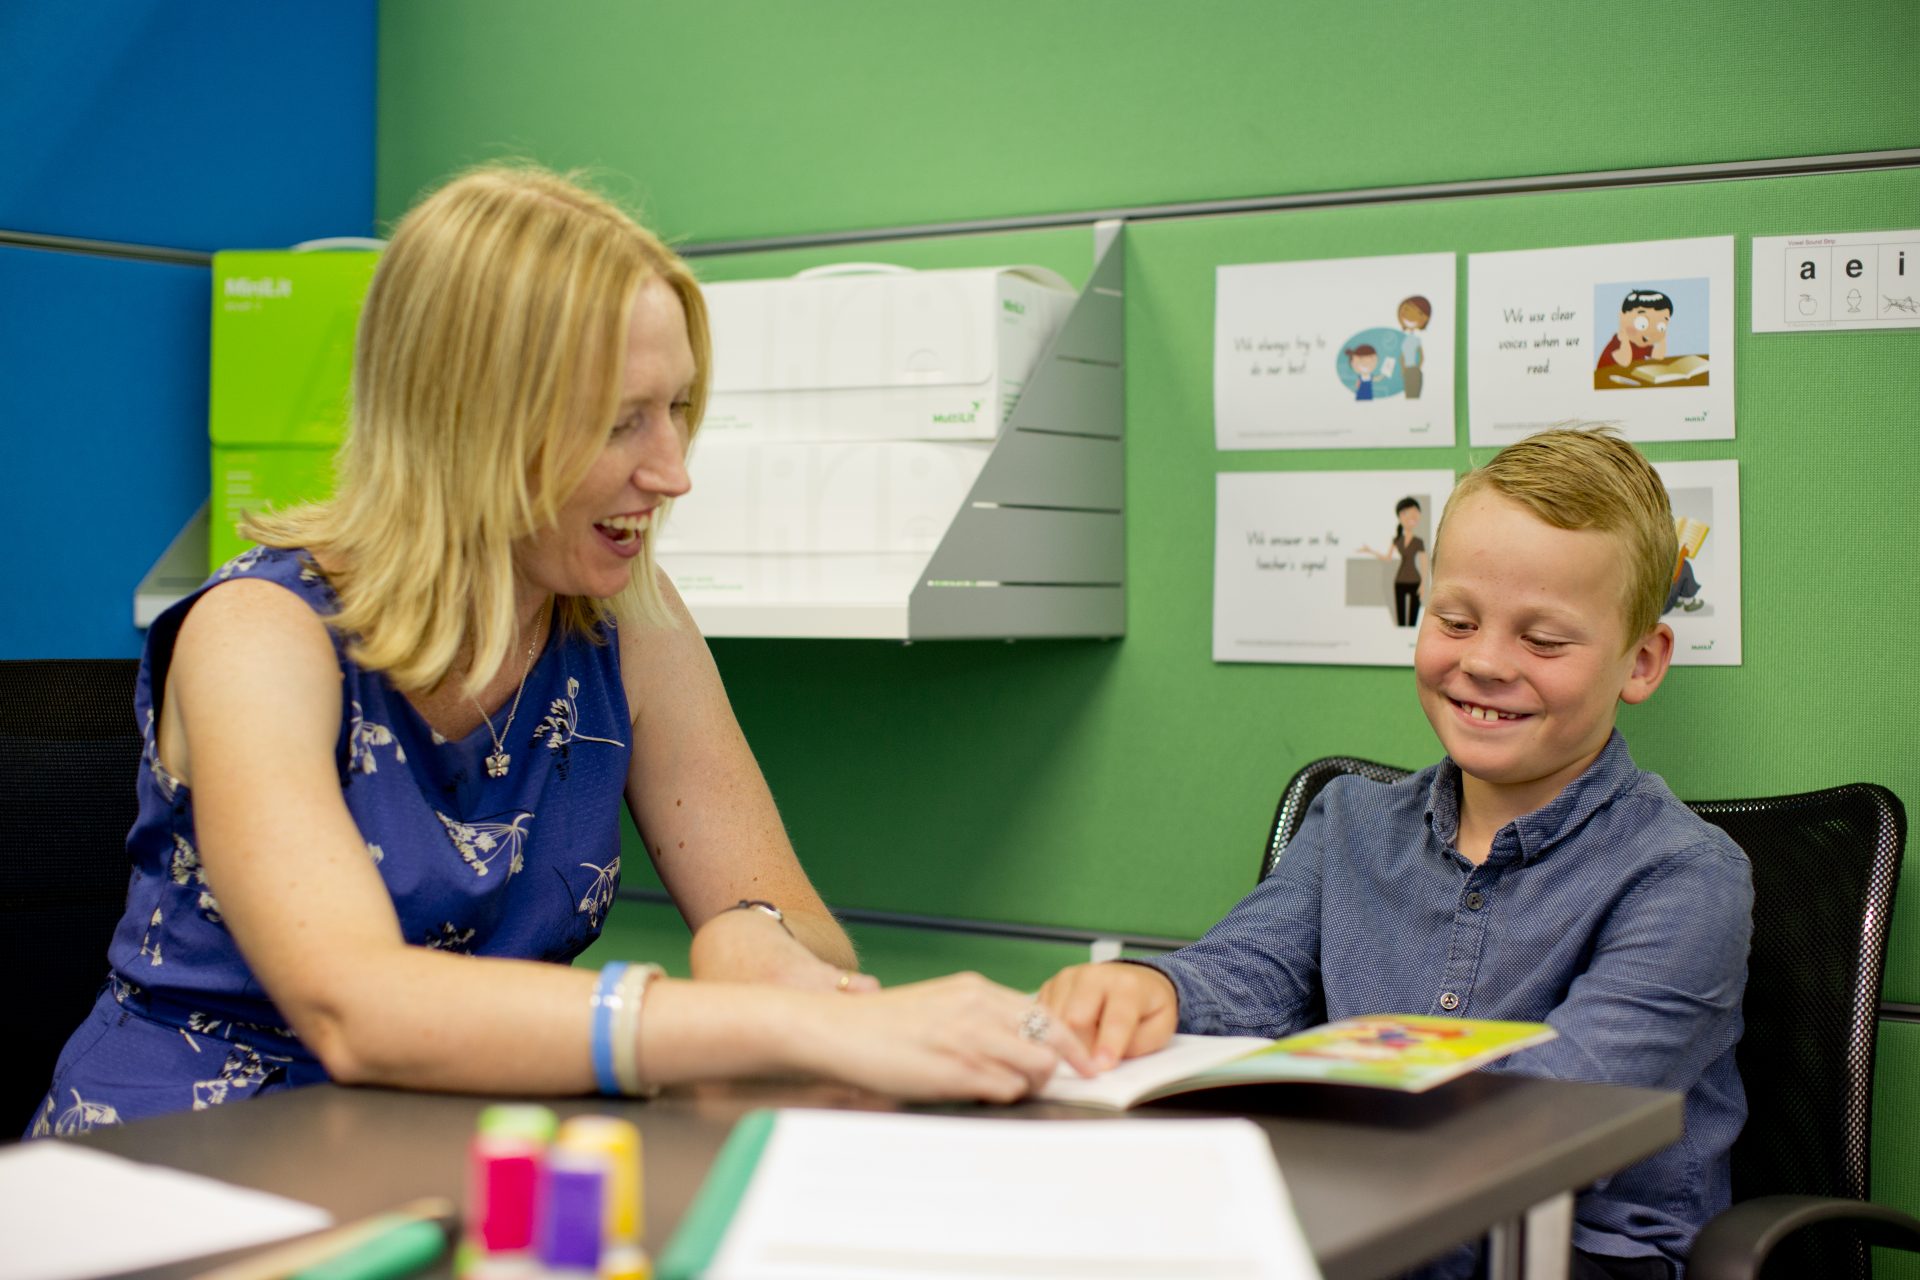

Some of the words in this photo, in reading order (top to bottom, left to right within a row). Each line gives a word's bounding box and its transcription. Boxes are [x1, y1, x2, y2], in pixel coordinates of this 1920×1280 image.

[1800, 260, 1816, 280] a
[1846, 258, 1863, 278] e
[1899, 251, 1905, 276] i
[1503, 307, 1524, 323] We
[1529, 313, 1545, 322] use
[1551, 305, 1576, 321] clear
[1499, 340, 1527, 349] voices
[1534, 332, 1560, 348] when
[1566, 337, 1580, 347] we
[1527, 357, 1550, 374] read
